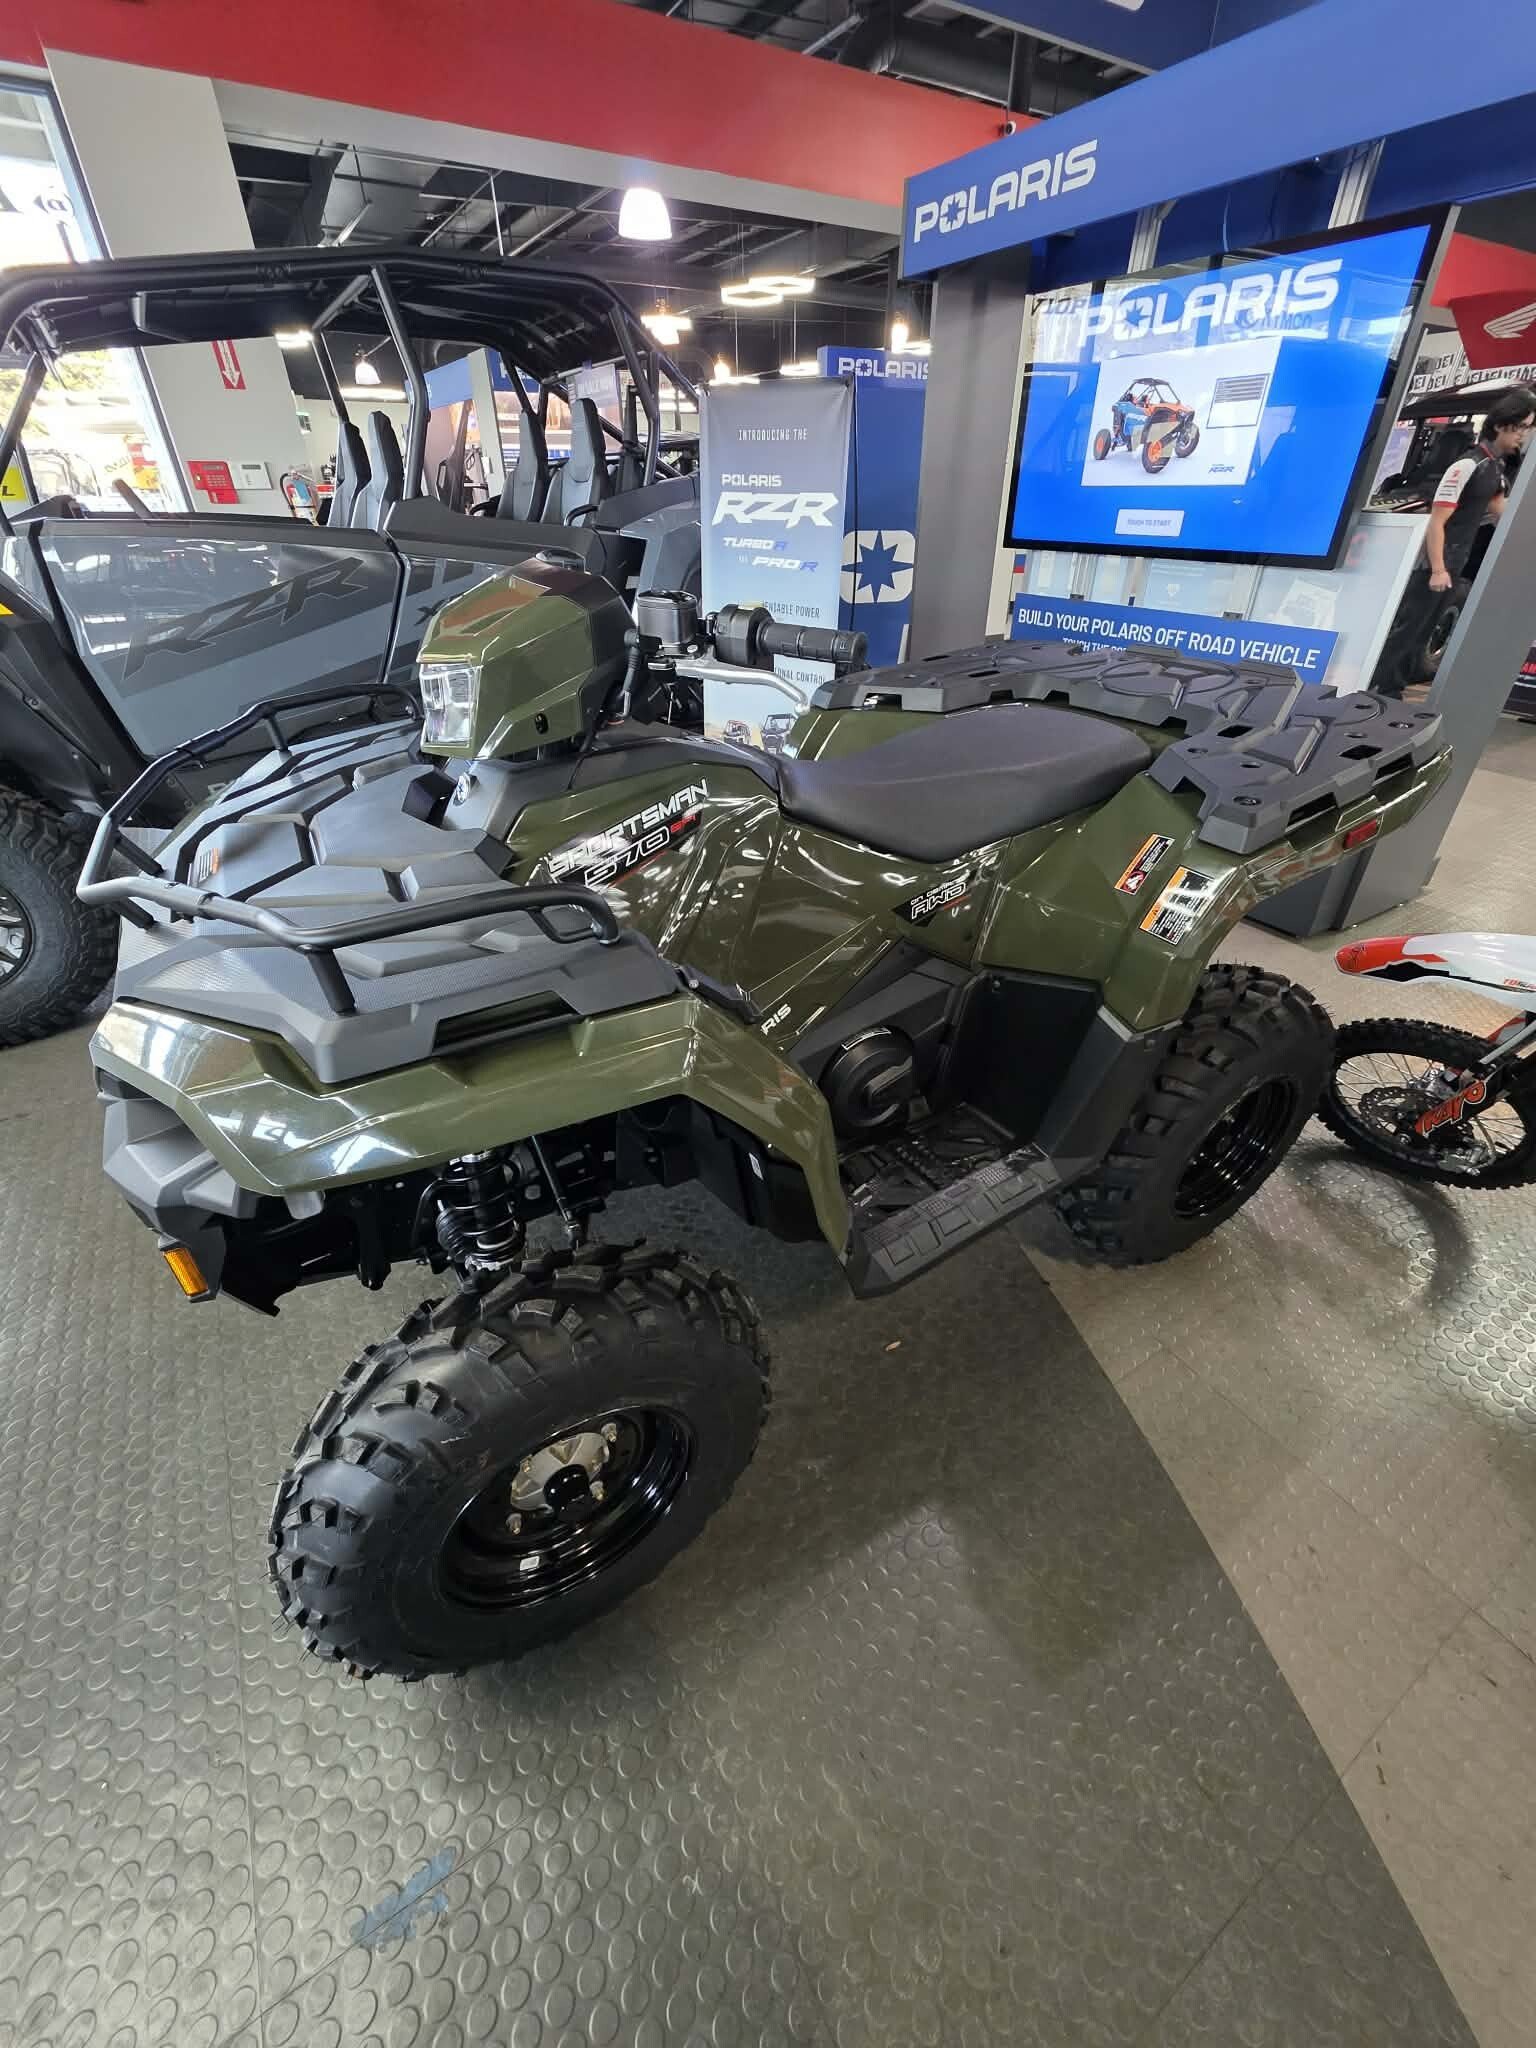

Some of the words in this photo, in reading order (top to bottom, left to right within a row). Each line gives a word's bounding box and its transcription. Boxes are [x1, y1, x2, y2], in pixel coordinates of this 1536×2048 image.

[914, 139, 1098, 243] POLARIS
[1078, 258, 1344, 347] POLARIS
[739, 429, 790, 440] INTRODUCING
[793, 428, 807, 440] THE
[722, 474, 782, 487] POLARIS
[711, 491, 839, 528] RZR
[796, 606, 820, 618] POWER
[1018, 608, 1053, 627] BUILD
[1056, 612, 1089, 632] YOUR
[1091, 618, 1152, 643] POLARIS
[1155, 627, 1188, 648] OFF
[1191, 632, 1236, 655] ROAD
[1239, 639, 1321, 669] VEHICLE
[550, 777, 709, 874] SPORTSMAN
[584, 825, 670, 890] 570
[912, 882, 966, 920] AWD
[761, 1003, 792, 1036] RIS
